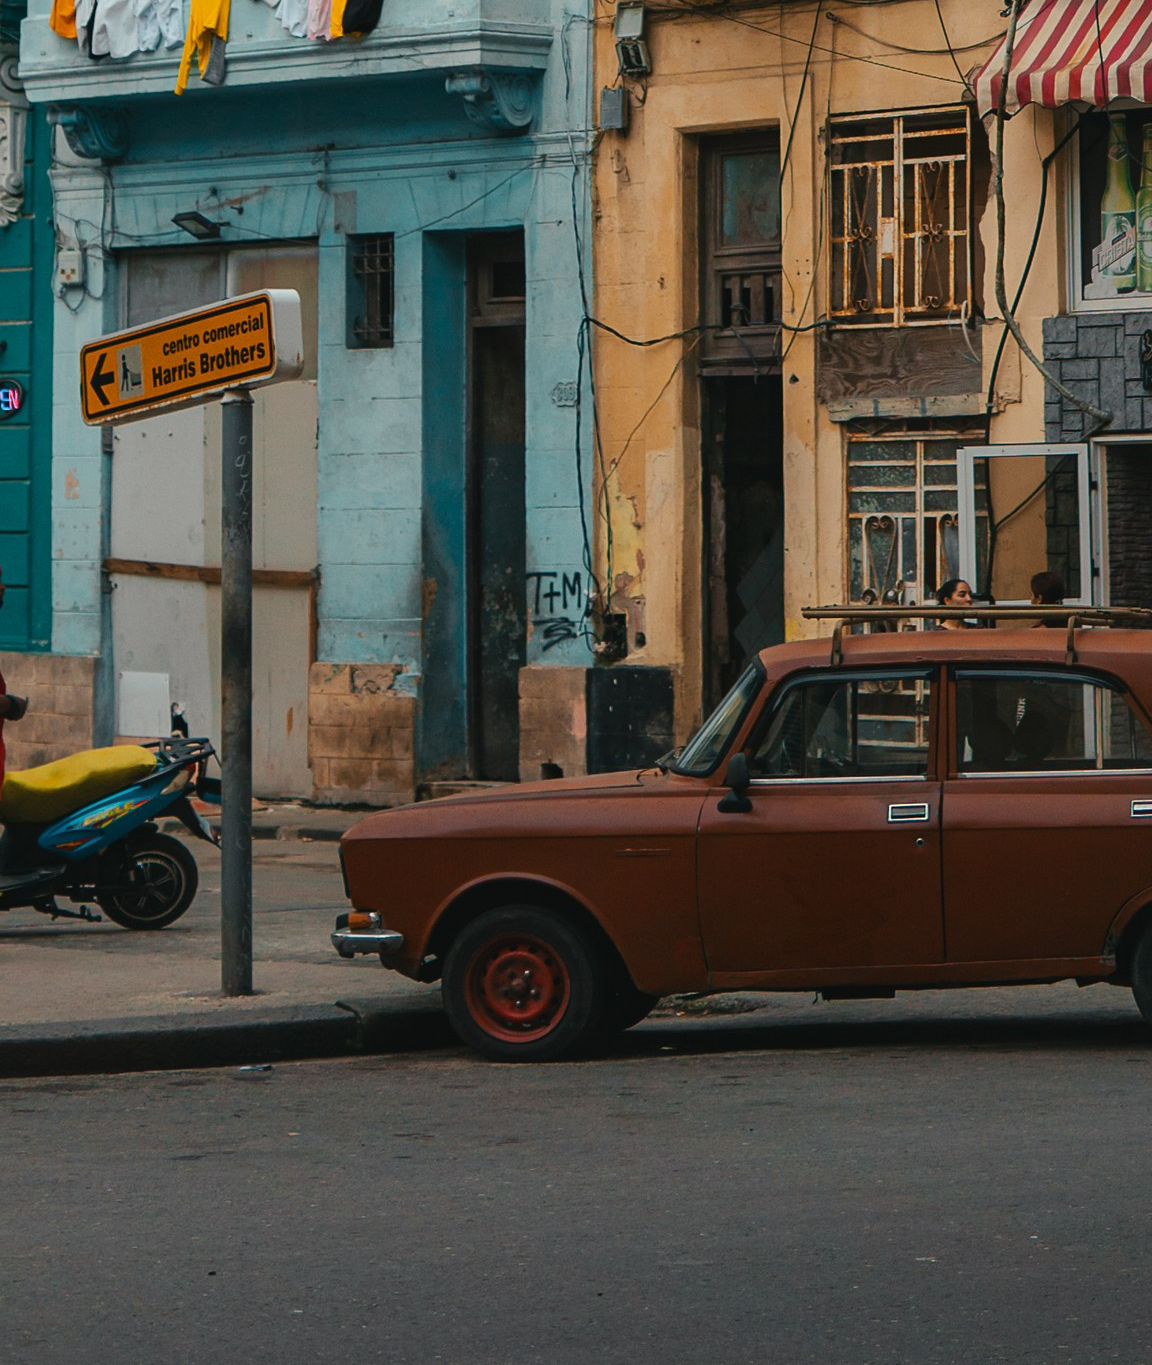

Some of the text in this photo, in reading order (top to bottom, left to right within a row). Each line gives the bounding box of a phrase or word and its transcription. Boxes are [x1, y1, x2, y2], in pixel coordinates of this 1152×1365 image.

[1100, 234, 1135, 267] CRISTA
[162, 312, 264, 356] centro comercial
[152, 342, 265, 388] Harris Brothers
[0, 388, 20, 411] EN
